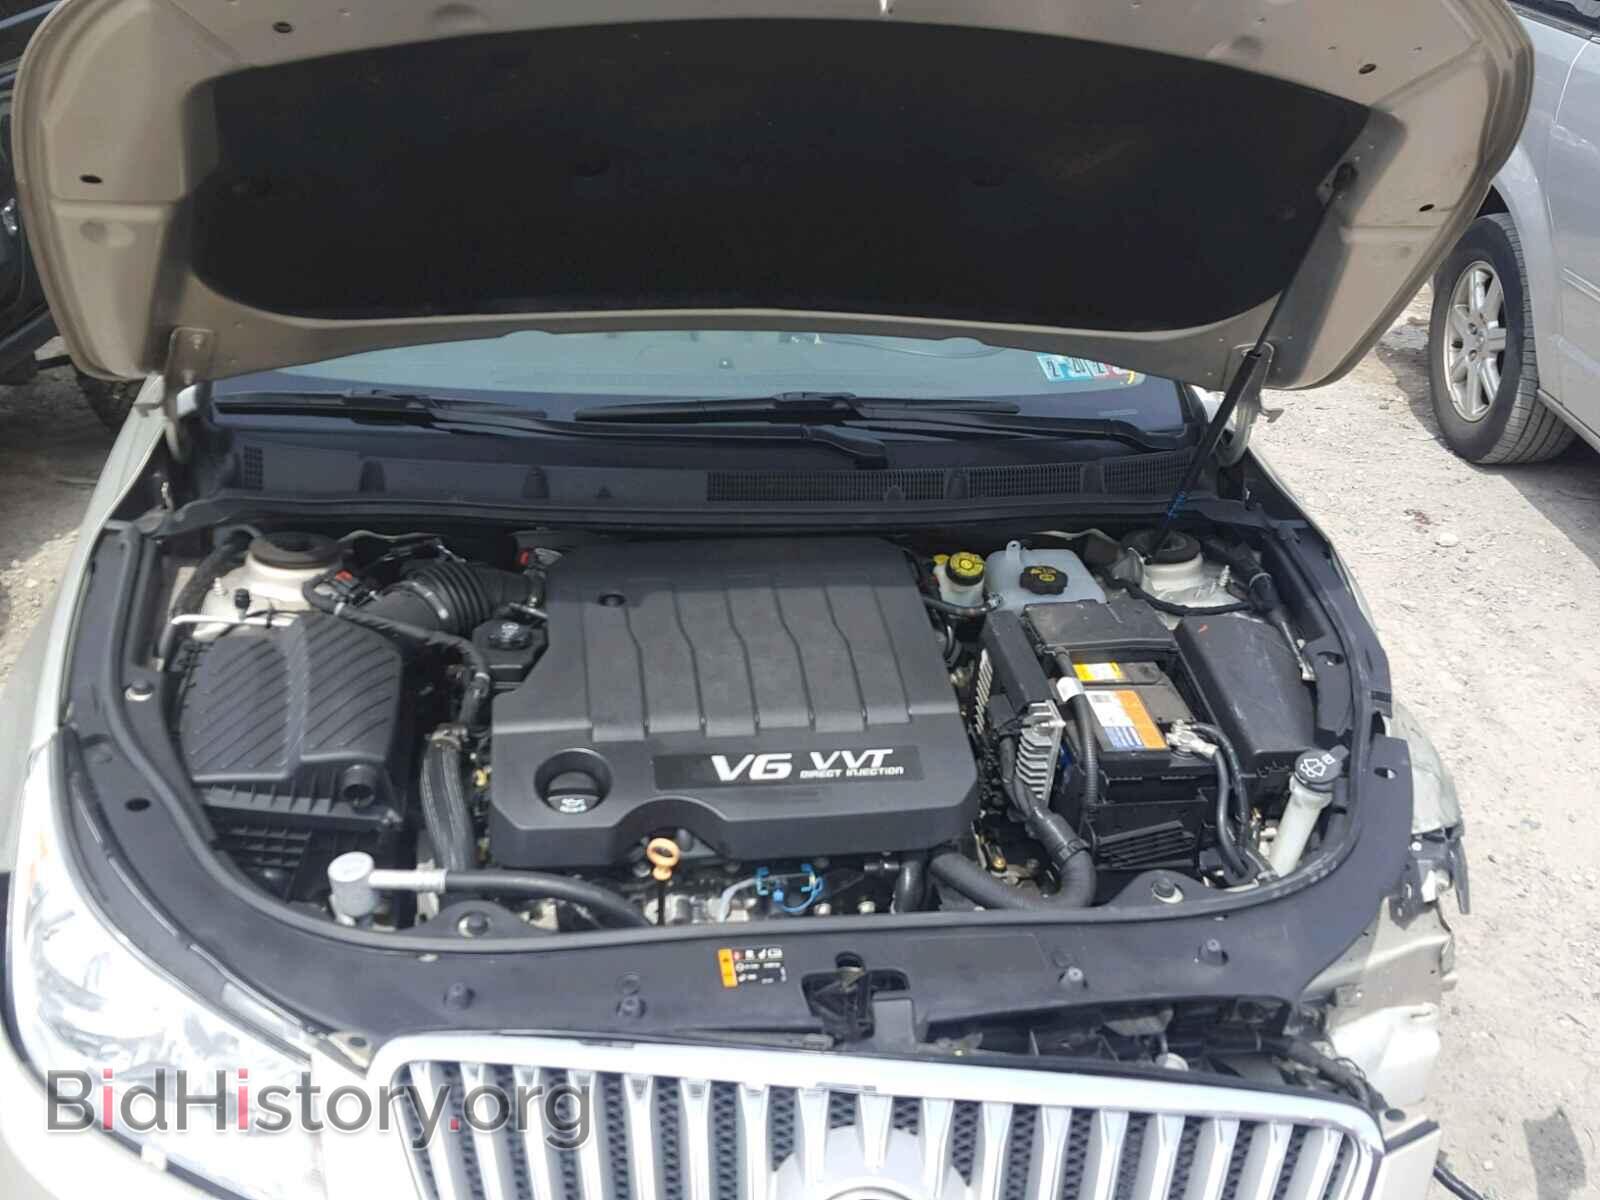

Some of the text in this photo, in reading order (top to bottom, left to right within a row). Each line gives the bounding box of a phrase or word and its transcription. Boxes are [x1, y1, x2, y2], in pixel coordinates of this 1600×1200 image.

[711, 748, 894, 781] V6 VVT
[799, 766, 904, 779] DIRECT INJECTION
